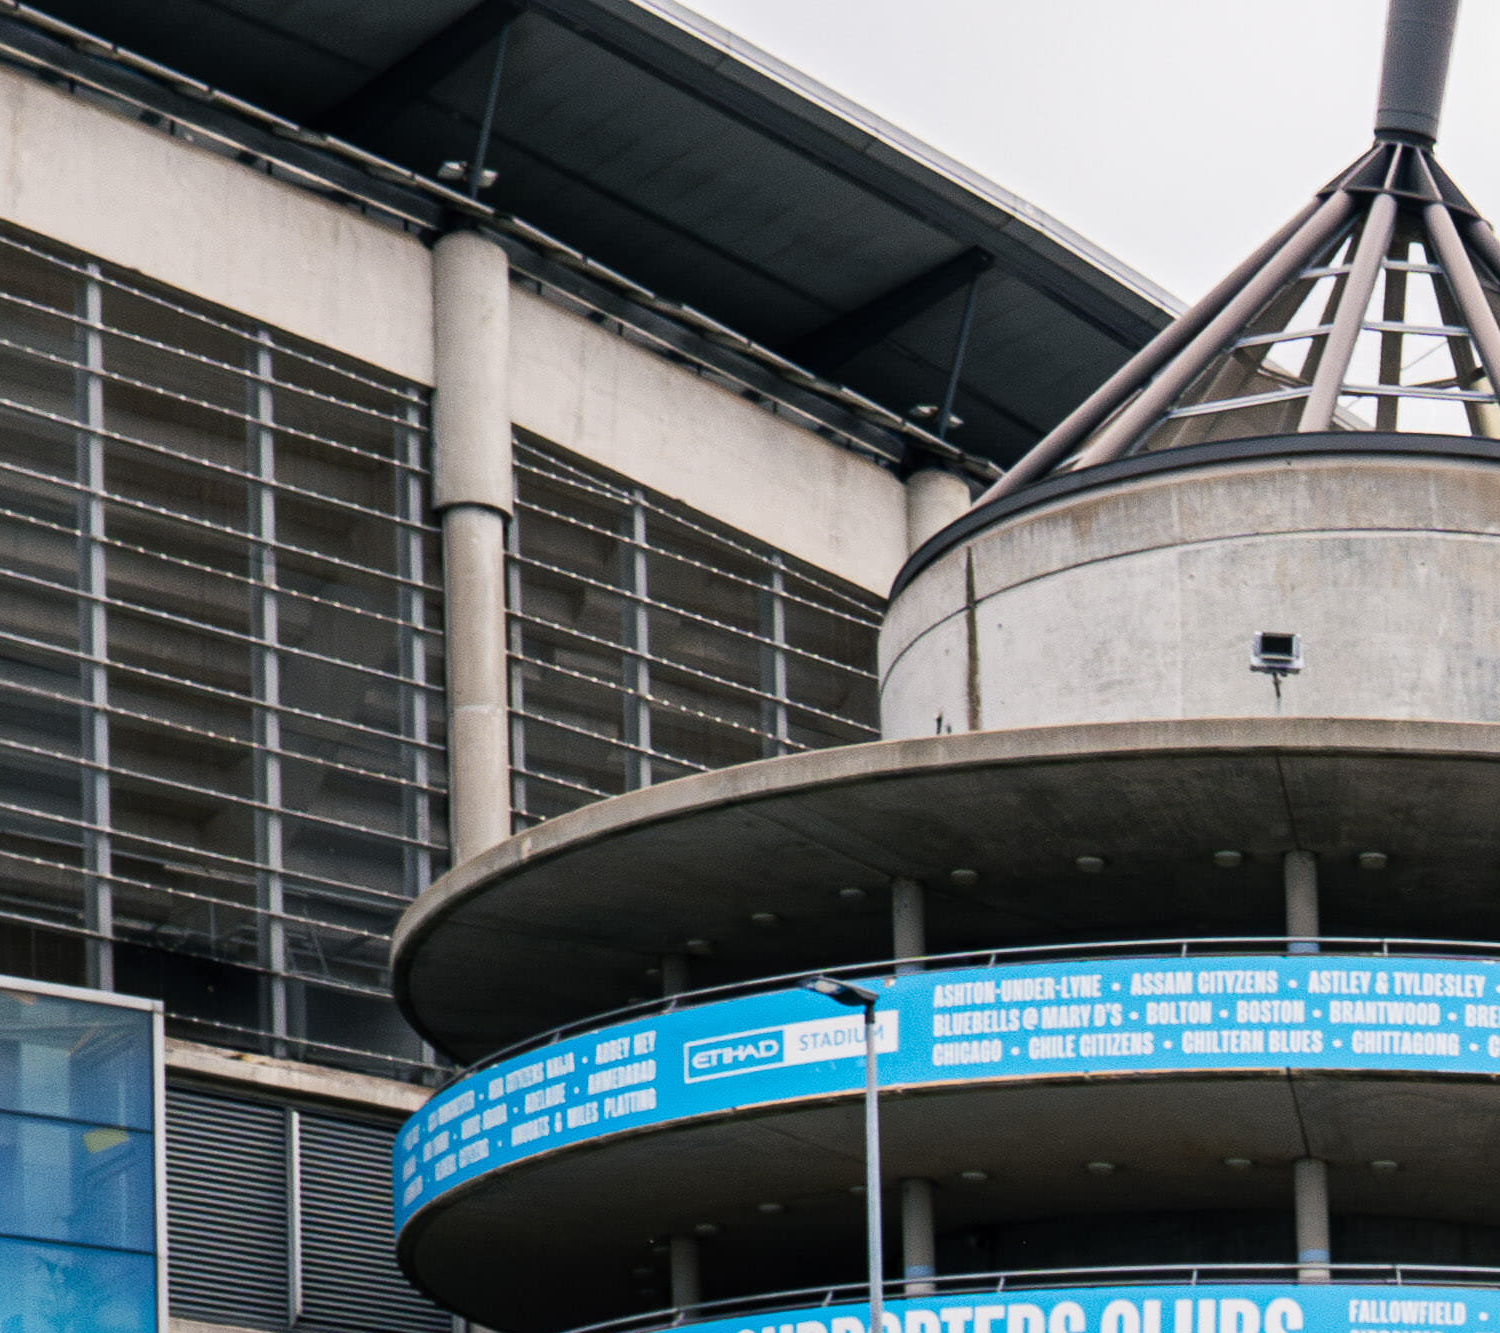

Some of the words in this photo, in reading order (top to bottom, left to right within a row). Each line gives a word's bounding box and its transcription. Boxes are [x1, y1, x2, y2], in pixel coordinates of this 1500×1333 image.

[934, 975, 1101, 1008] ASHTON-UNDER-LYNE
[1131, 971, 1193, 995] ASSAM
[1198, 970, 1278, 994] CITYZENS
[1308, 971, 1370, 994] ASTLEY
[1395, 972, 1485, 997] TYLDESLEY
[933, 1009, 1020, 1037] BLUEBELLS
[1041, 1004, 1097, 1029] MARY
[1146, 1001, 1212, 1025] BOLTON
[1236, 1000, 1305, 1023] BOSTON
[1330, 1001, 1440, 1025] BRANTWOOD
[691, 1037, 780, 1071] ETIHAD
[799, 1025, 885, 1053] STADIUM
[932, 1039, 1002, 1066] CHICAGO
[1029, 1035, 1075, 1060] CHILE
[1079, 1032, 1154, 1057] CITIZENS
[1182, 1030, 1260, 1054] CHILTERN
[1261, 1030, 1323, 1053] BLUES
[1352, 1031, 1460, 1056] CHITTAGONG
[1349, 1300, 1466, 1325] FALLOWFIELD
